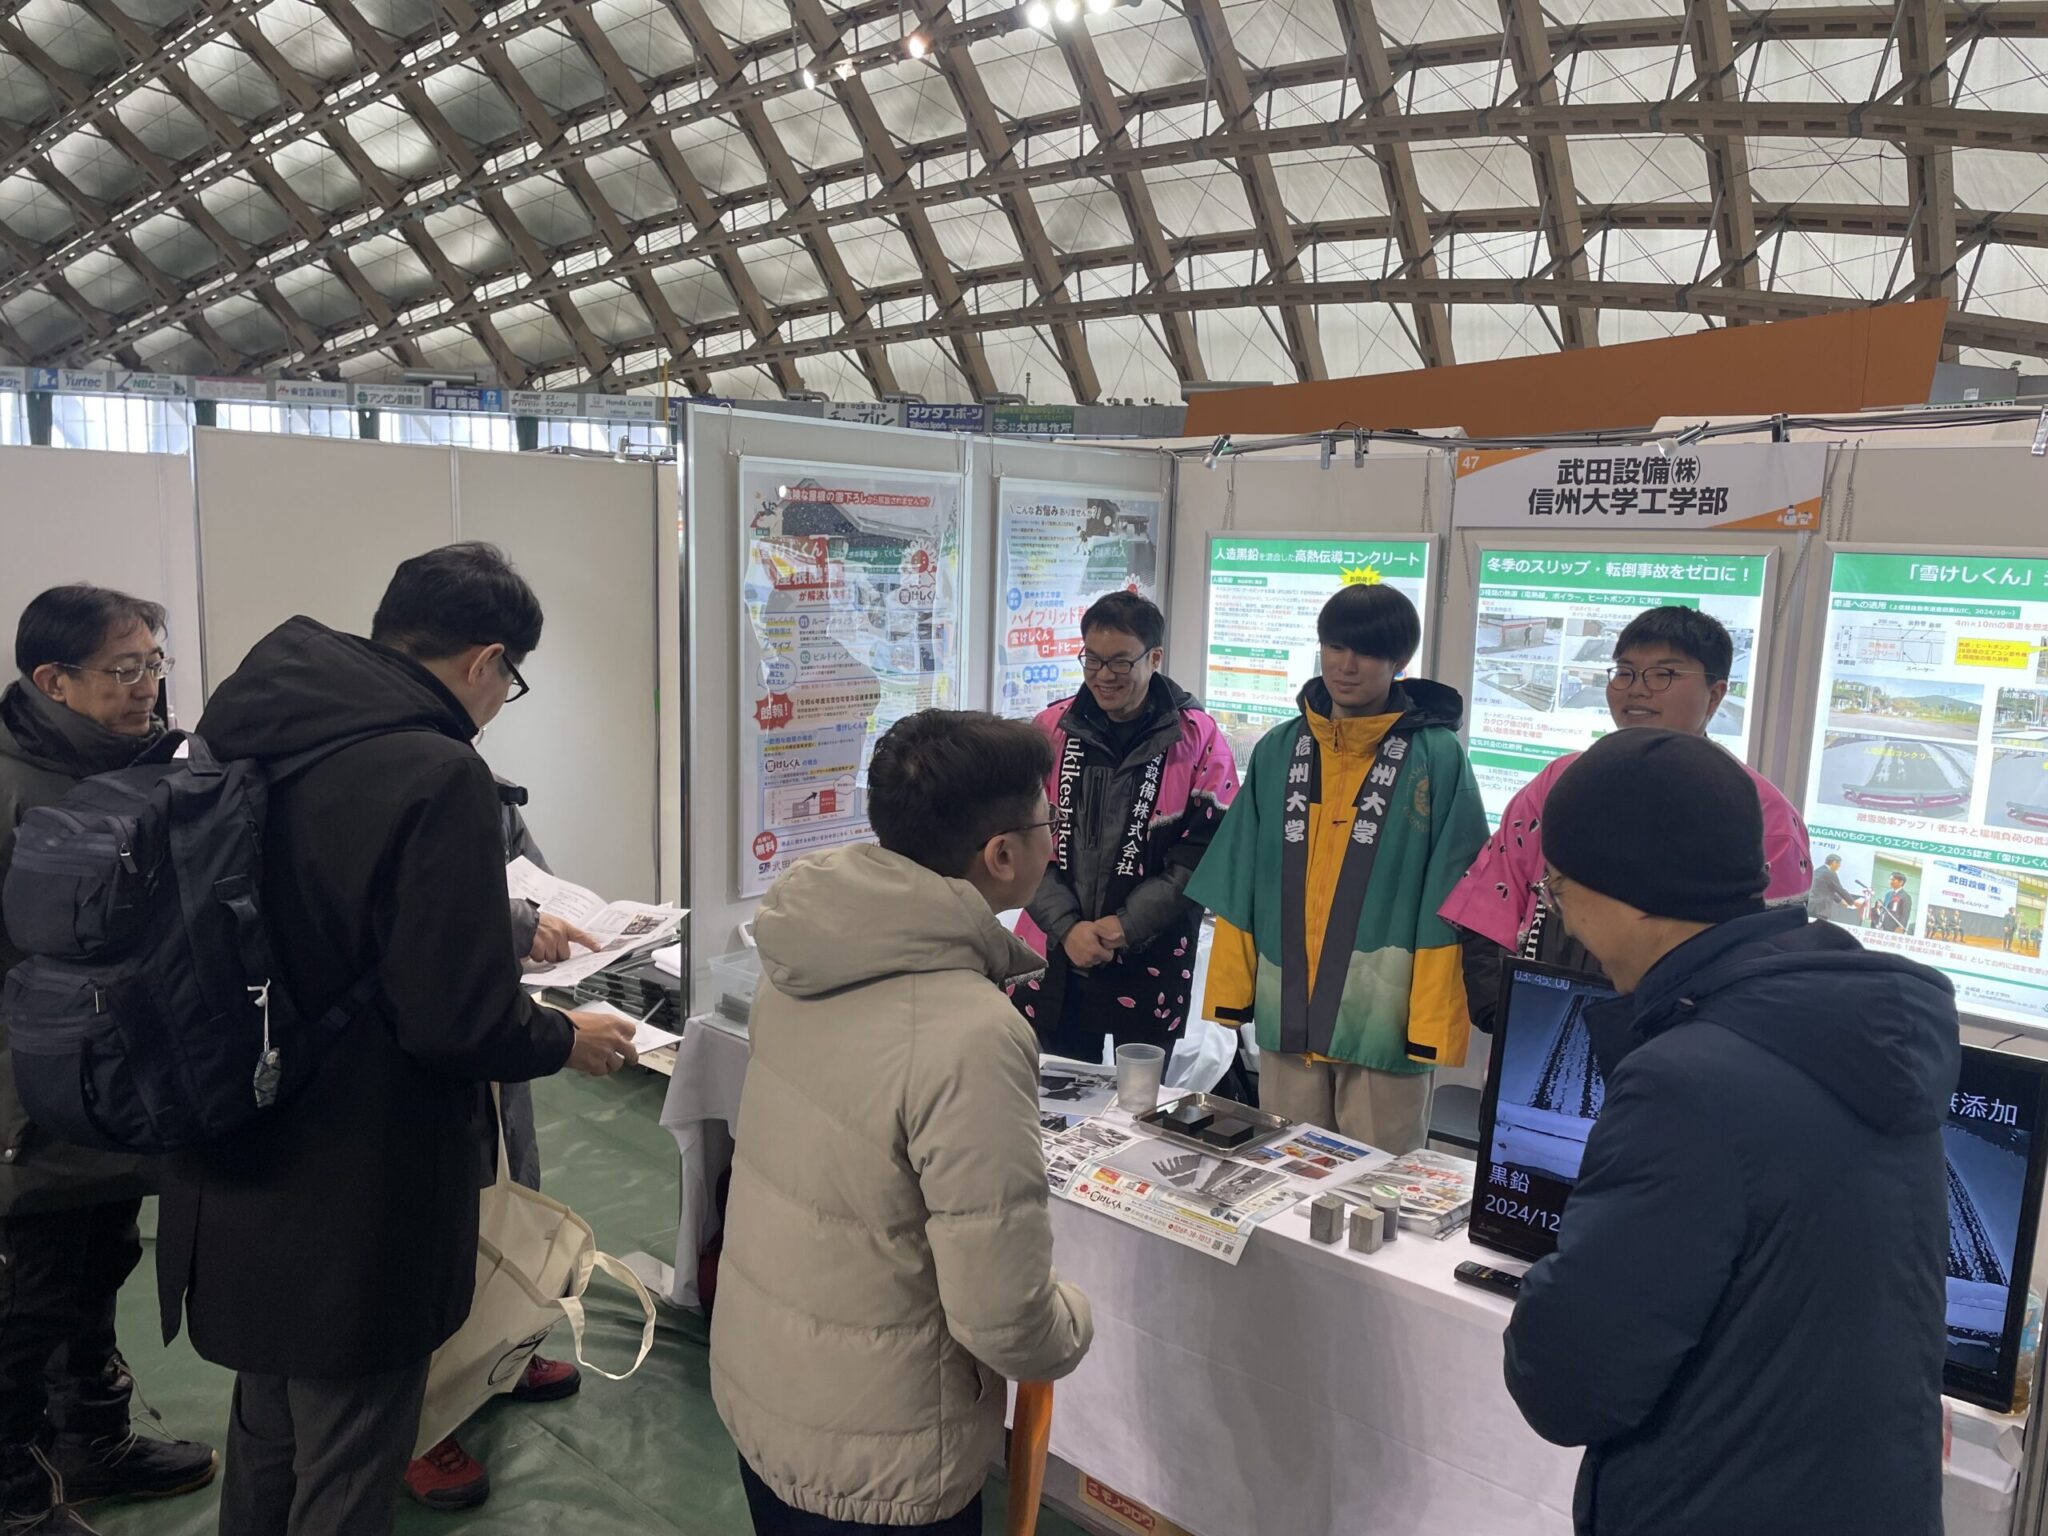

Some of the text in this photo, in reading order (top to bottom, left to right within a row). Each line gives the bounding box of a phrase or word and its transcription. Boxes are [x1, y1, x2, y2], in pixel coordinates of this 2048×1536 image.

[65, 373, 102, 387] Yurtec
[132, 380, 157, 389] NBC
[908, 406, 983, 420] タケダスポーツ
[1462, 456, 1480, 469] 47
[1527, 487, 1730, 517] 信州大学工学部
[1214, 547, 1420, 567] 人造黒鉛を混合した高熱伝導コンクリート
[1487, 557, 1751, 583] 冬季のスリップ・転倒事故をゼロに！
[1909, 563, 2032, 587] 「雪けしくん」
[1284, 734, 1312, 843] 信州大学
[1351, 735, 1408, 845] 信州大学
[754, 840, 776, 858] 無料
[1487, 1164, 1530, 1195] 黒鉛
[1101, 1490, 1154, 1530] モノタロウ
